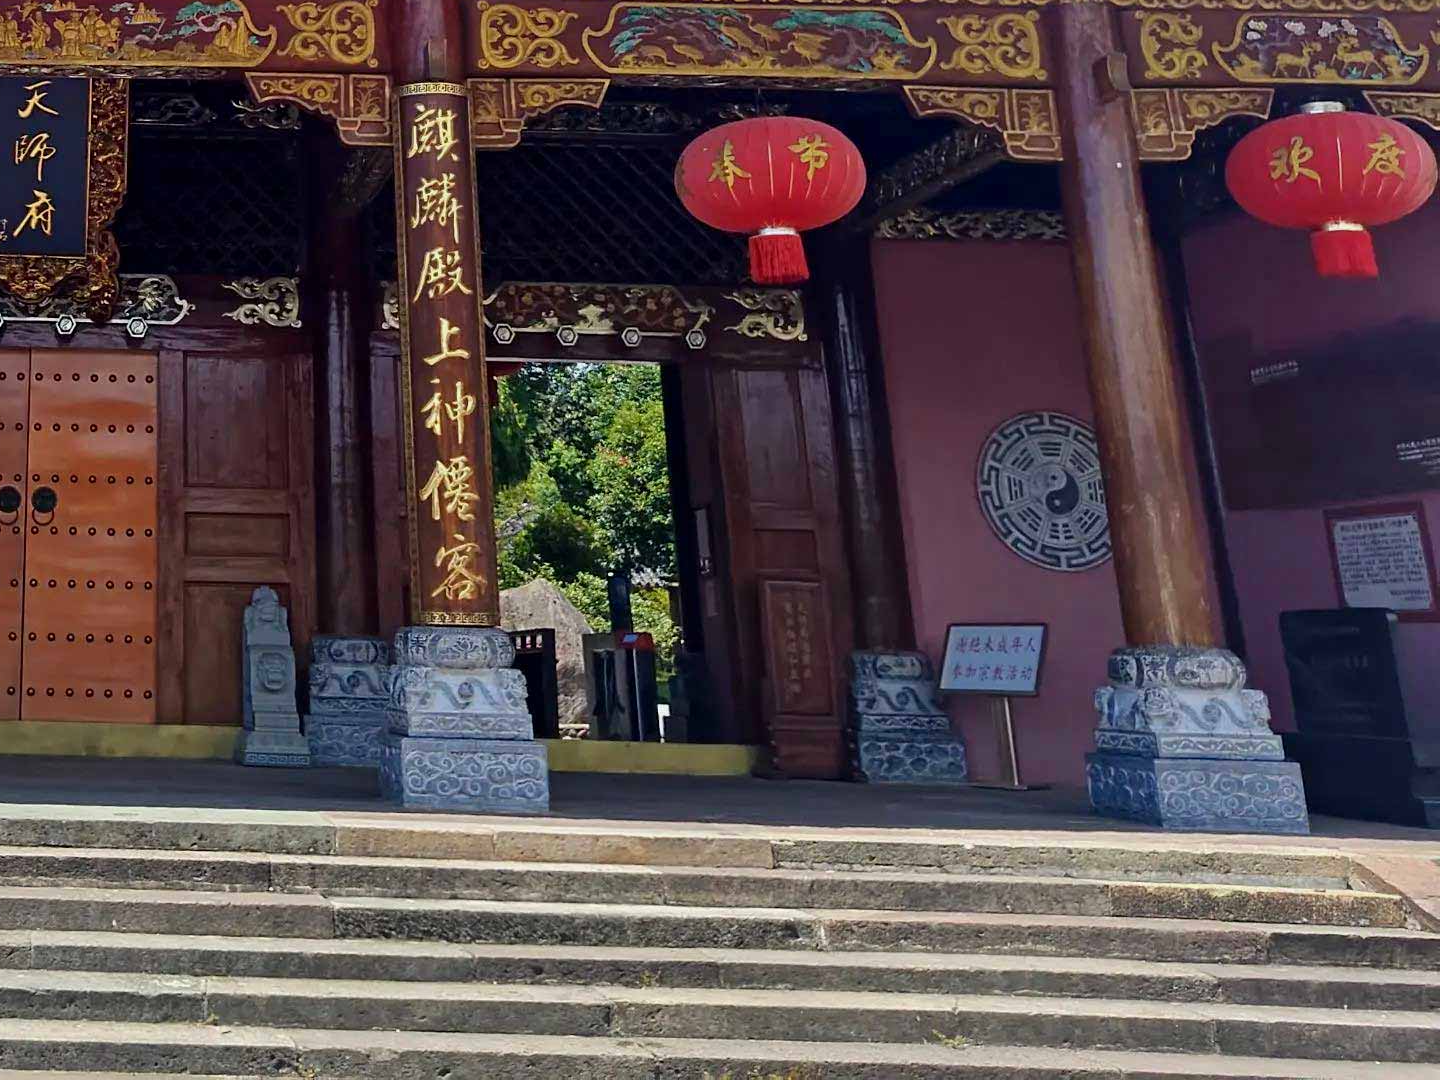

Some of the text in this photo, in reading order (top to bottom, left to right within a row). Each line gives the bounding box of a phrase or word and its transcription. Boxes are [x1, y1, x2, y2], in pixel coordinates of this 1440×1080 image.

[12, 80, 59, 237] 天師府
[708, 134, 832, 189] 春节
[1269, 131, 1407, 184] 欢度
